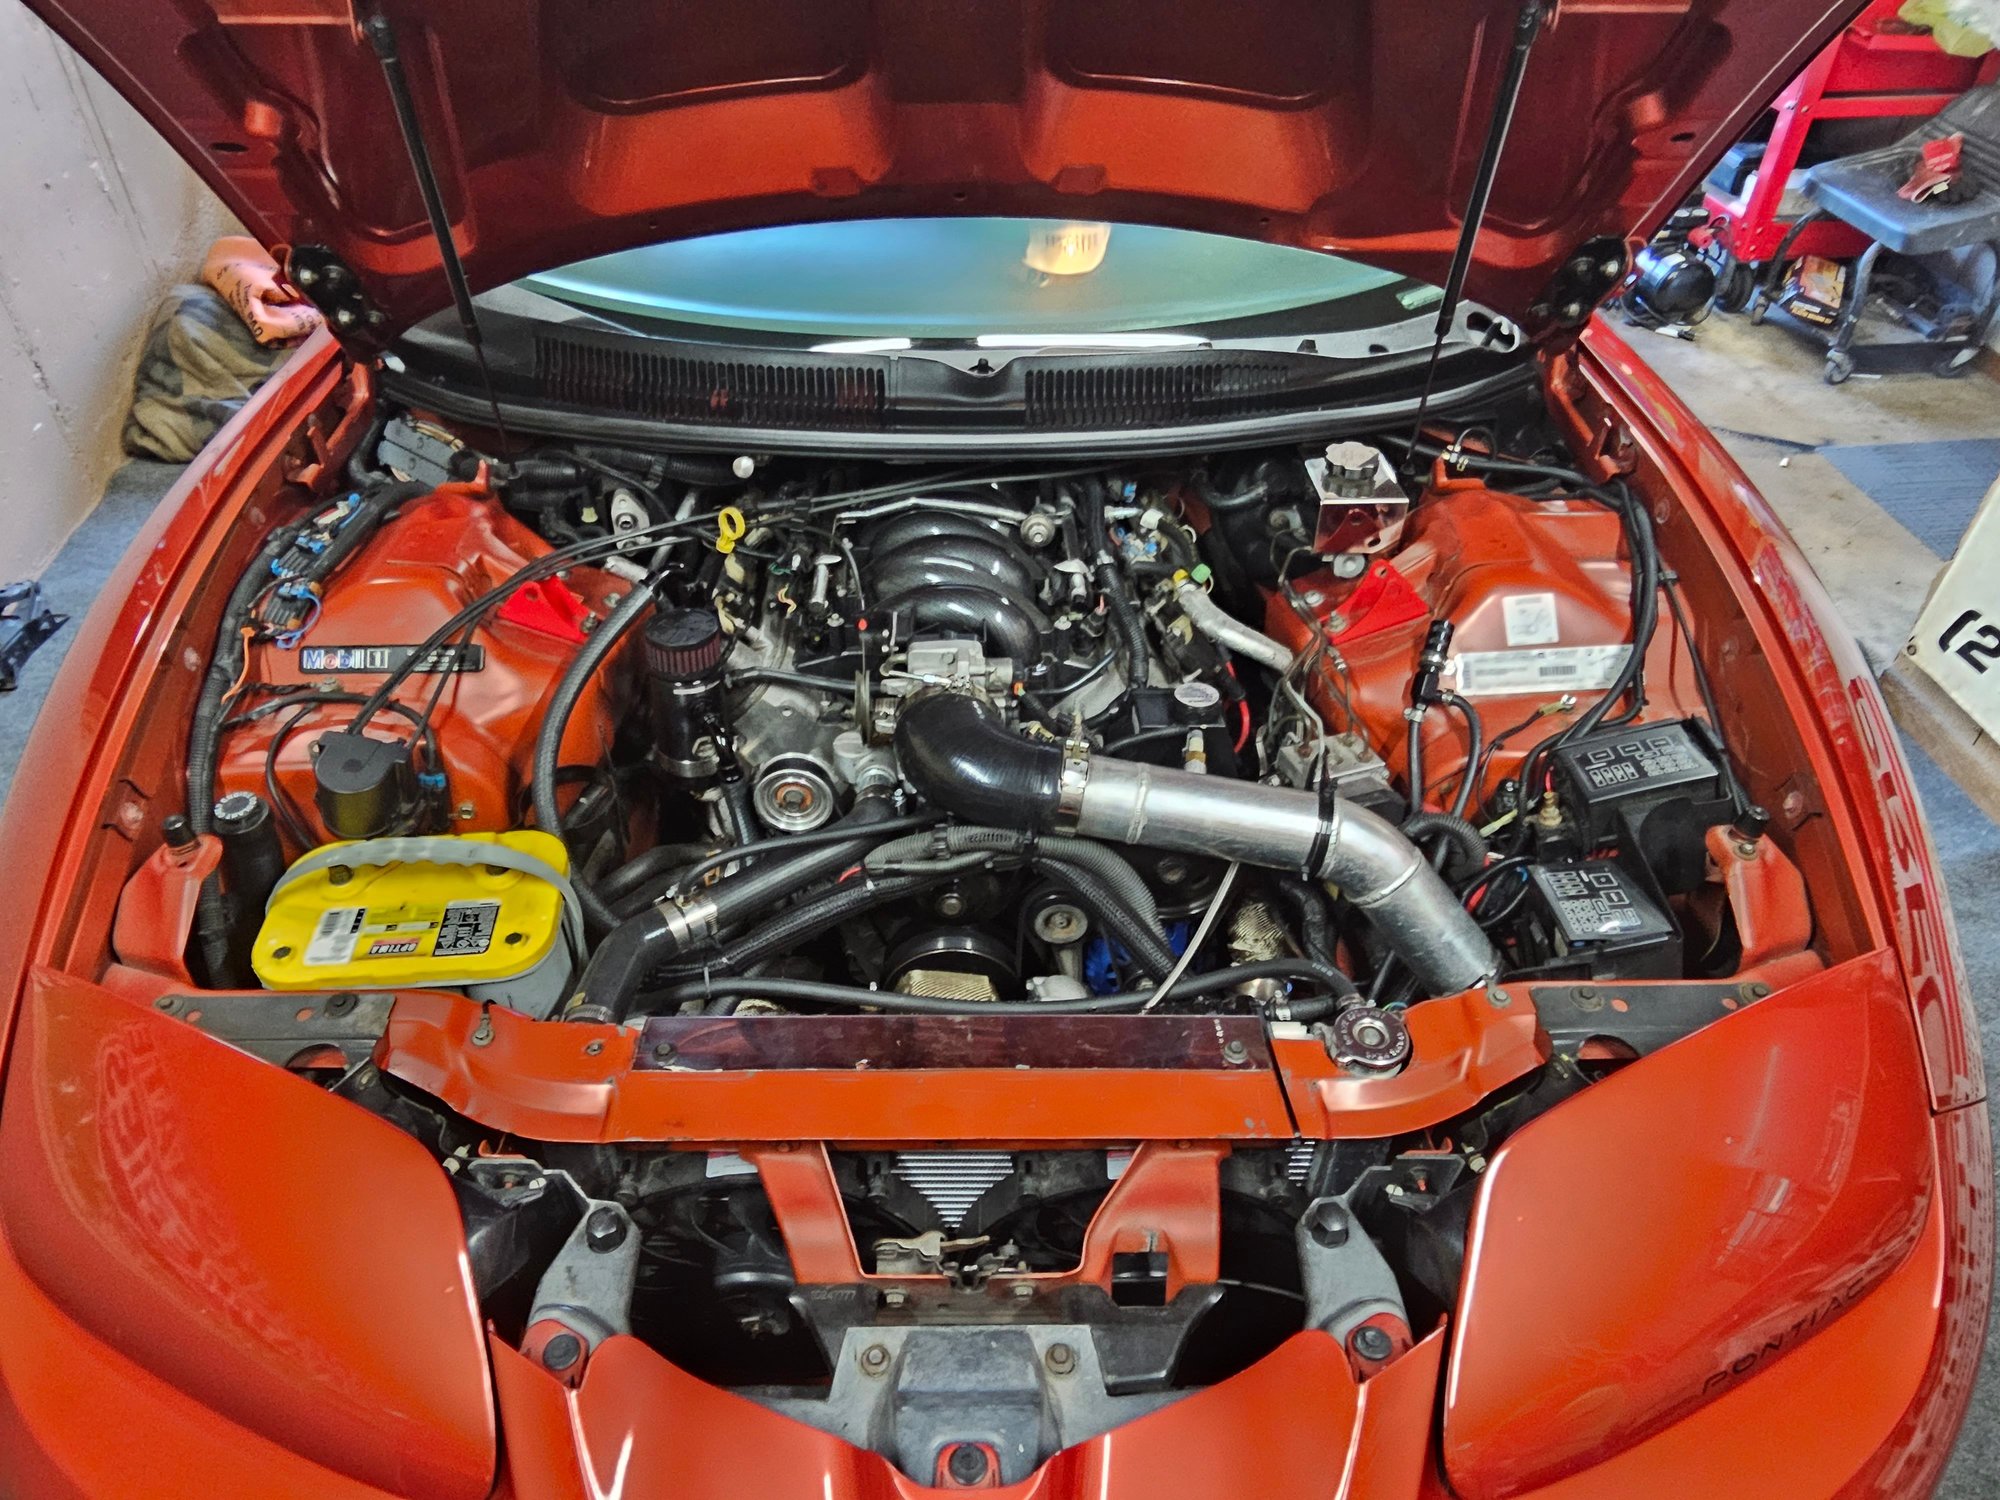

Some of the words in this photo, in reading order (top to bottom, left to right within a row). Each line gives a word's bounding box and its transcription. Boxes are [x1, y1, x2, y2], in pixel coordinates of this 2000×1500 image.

[303, 648, 365, 670] Mobil
[371, 942, 417, 954] OPTIMA
[1701, 1277, 1867, 1395] PONTIAC
